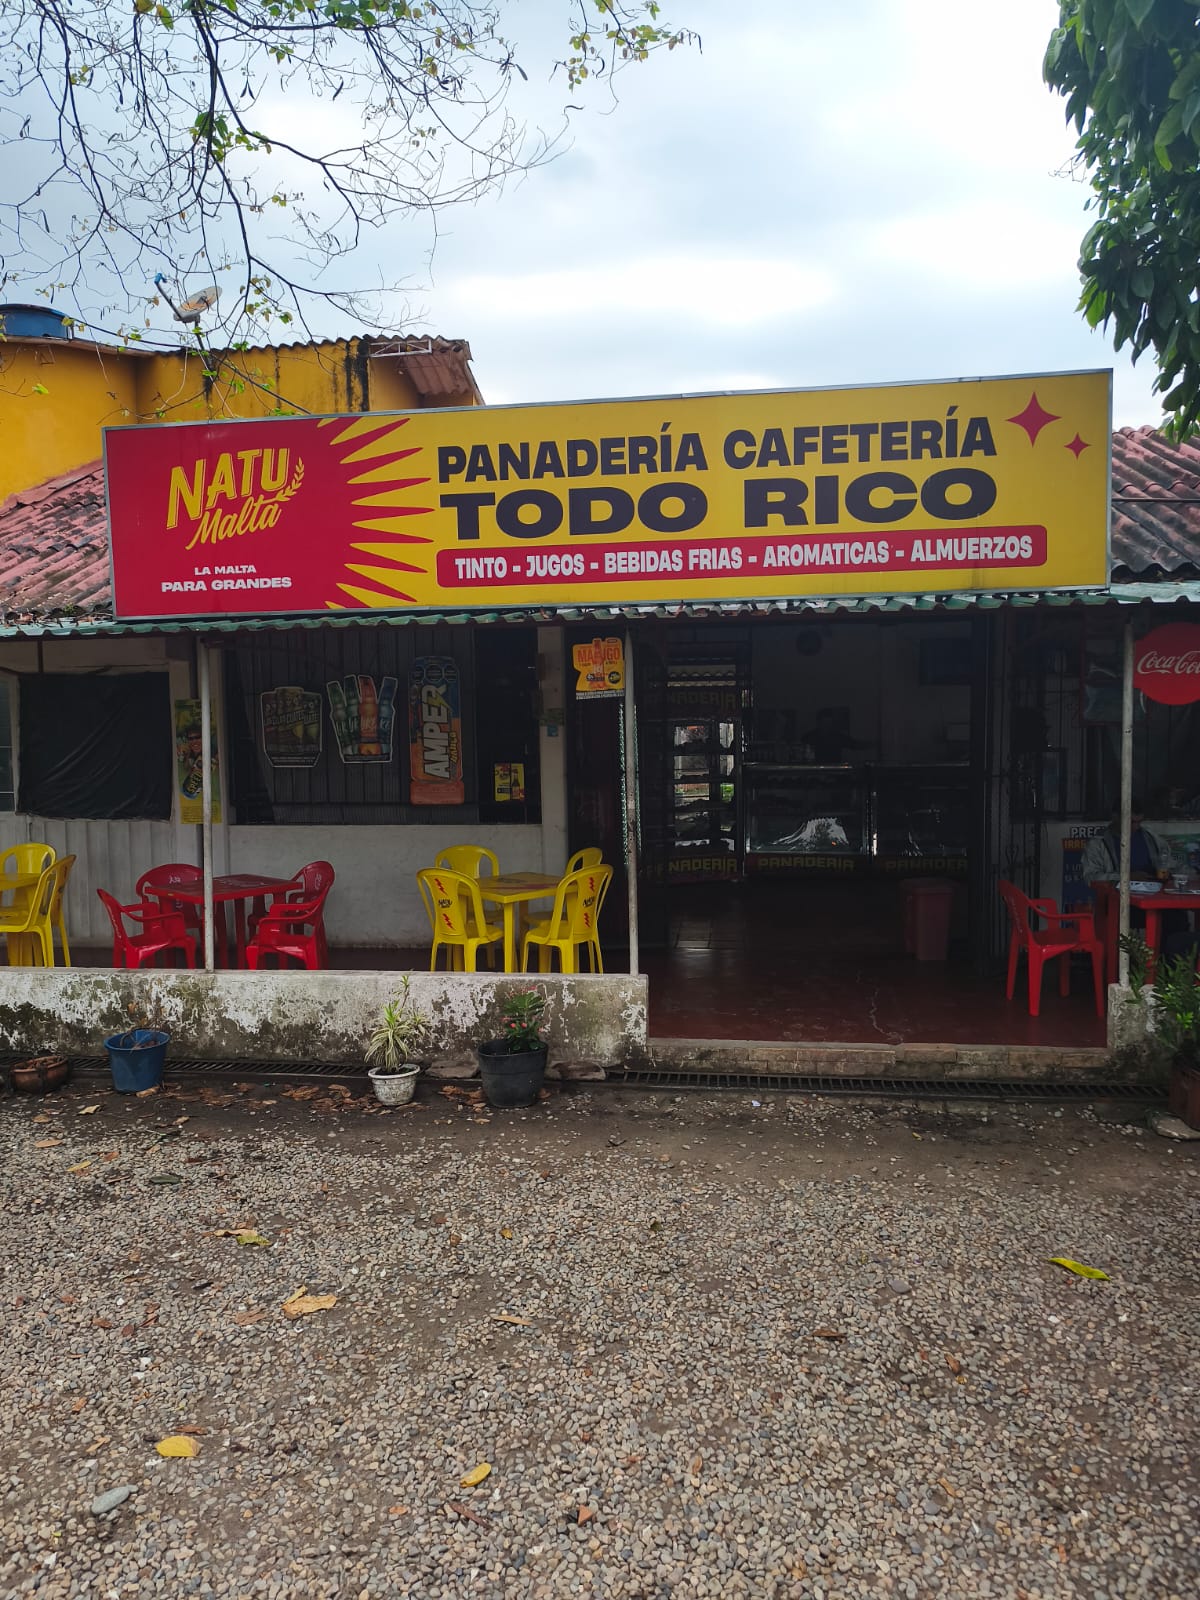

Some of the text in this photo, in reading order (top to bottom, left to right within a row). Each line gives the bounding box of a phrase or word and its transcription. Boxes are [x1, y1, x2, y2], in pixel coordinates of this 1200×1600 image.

[438, 406, 997, 483] PANADERÍA CAFETERÍA
[167, 448, 290, 530] NATU
[440, 468, 997, 540] TODO RICO
[185, 495, 283, 551] Malta
[161, 577, 292, 592] PARA GRANDES
[194, 565, 257, 576] LA MALTA
[455, 557, 508, 579] TINTO
[527, 554, 585, 577] JUGOS
[605, 550, 683, 574] BEBIDAS
[689, 547, 743, 571] FRIAS
[763, 541, 890, 568] AROMATICAS
[911, 536, 1033, 563] ALMUERZOS
[421, 684, 451, 780] AMPER
